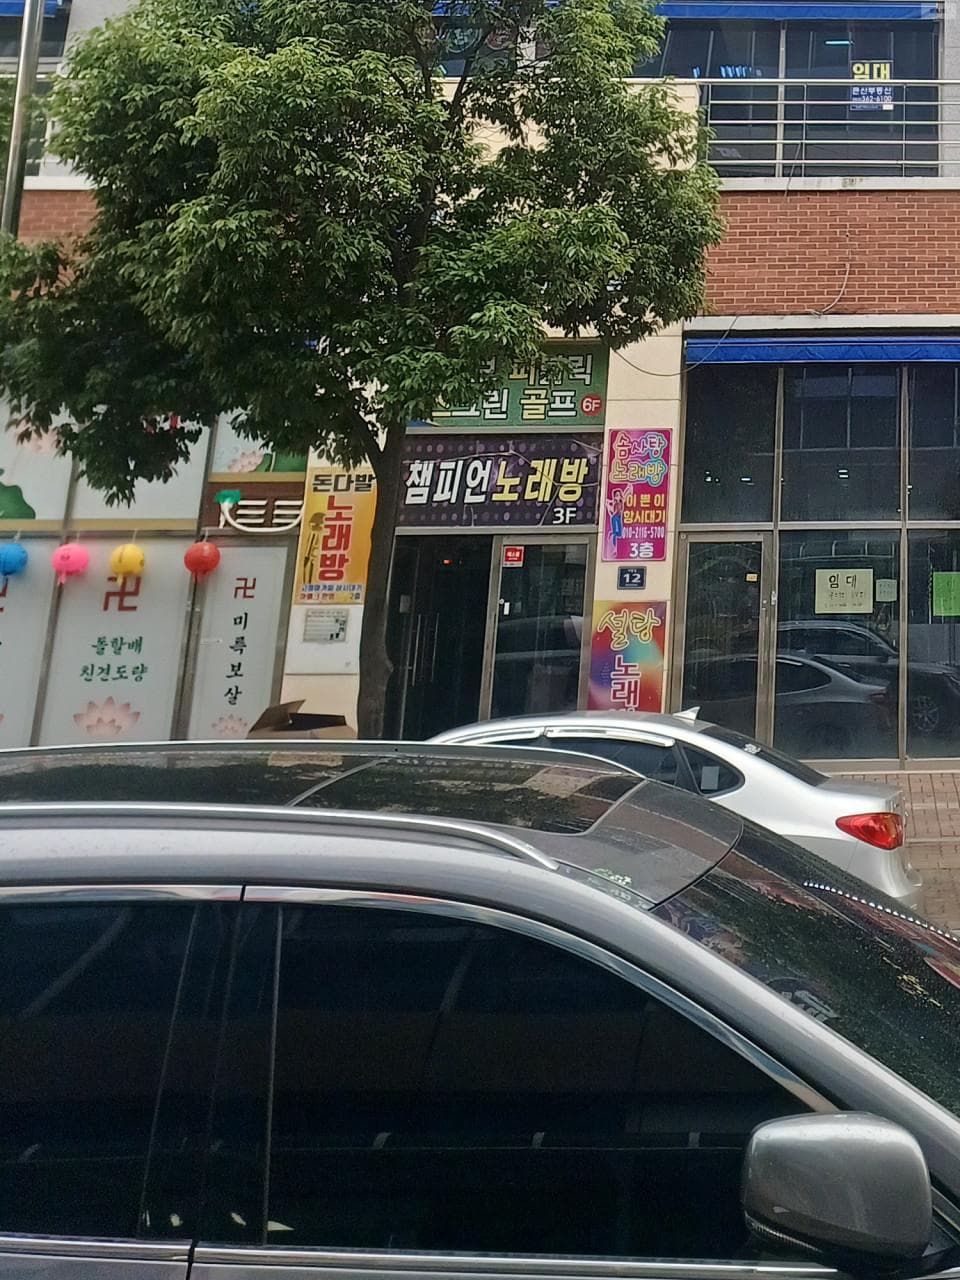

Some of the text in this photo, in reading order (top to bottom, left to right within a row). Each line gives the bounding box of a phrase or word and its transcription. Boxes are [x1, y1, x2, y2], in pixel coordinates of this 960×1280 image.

[852, 63, 890, 81] 임대
[520, 389, 577, 420] 골프
[582, 398, 601, 412] 6F
[615, 432, 665, 459] 솜사탕
[313, 473, 376, 493] 돈다발
[612, 460, 664, 483] 노래방
[552, 507, 577, 525] 3F
[318, 495, 353, 582] 노래방
[629, 542, 654, 558] 3층
[623, 573, 641, 583] 12
[598, 609, 662, 651] 설탕
[611, 656, 641, 708] 노래
